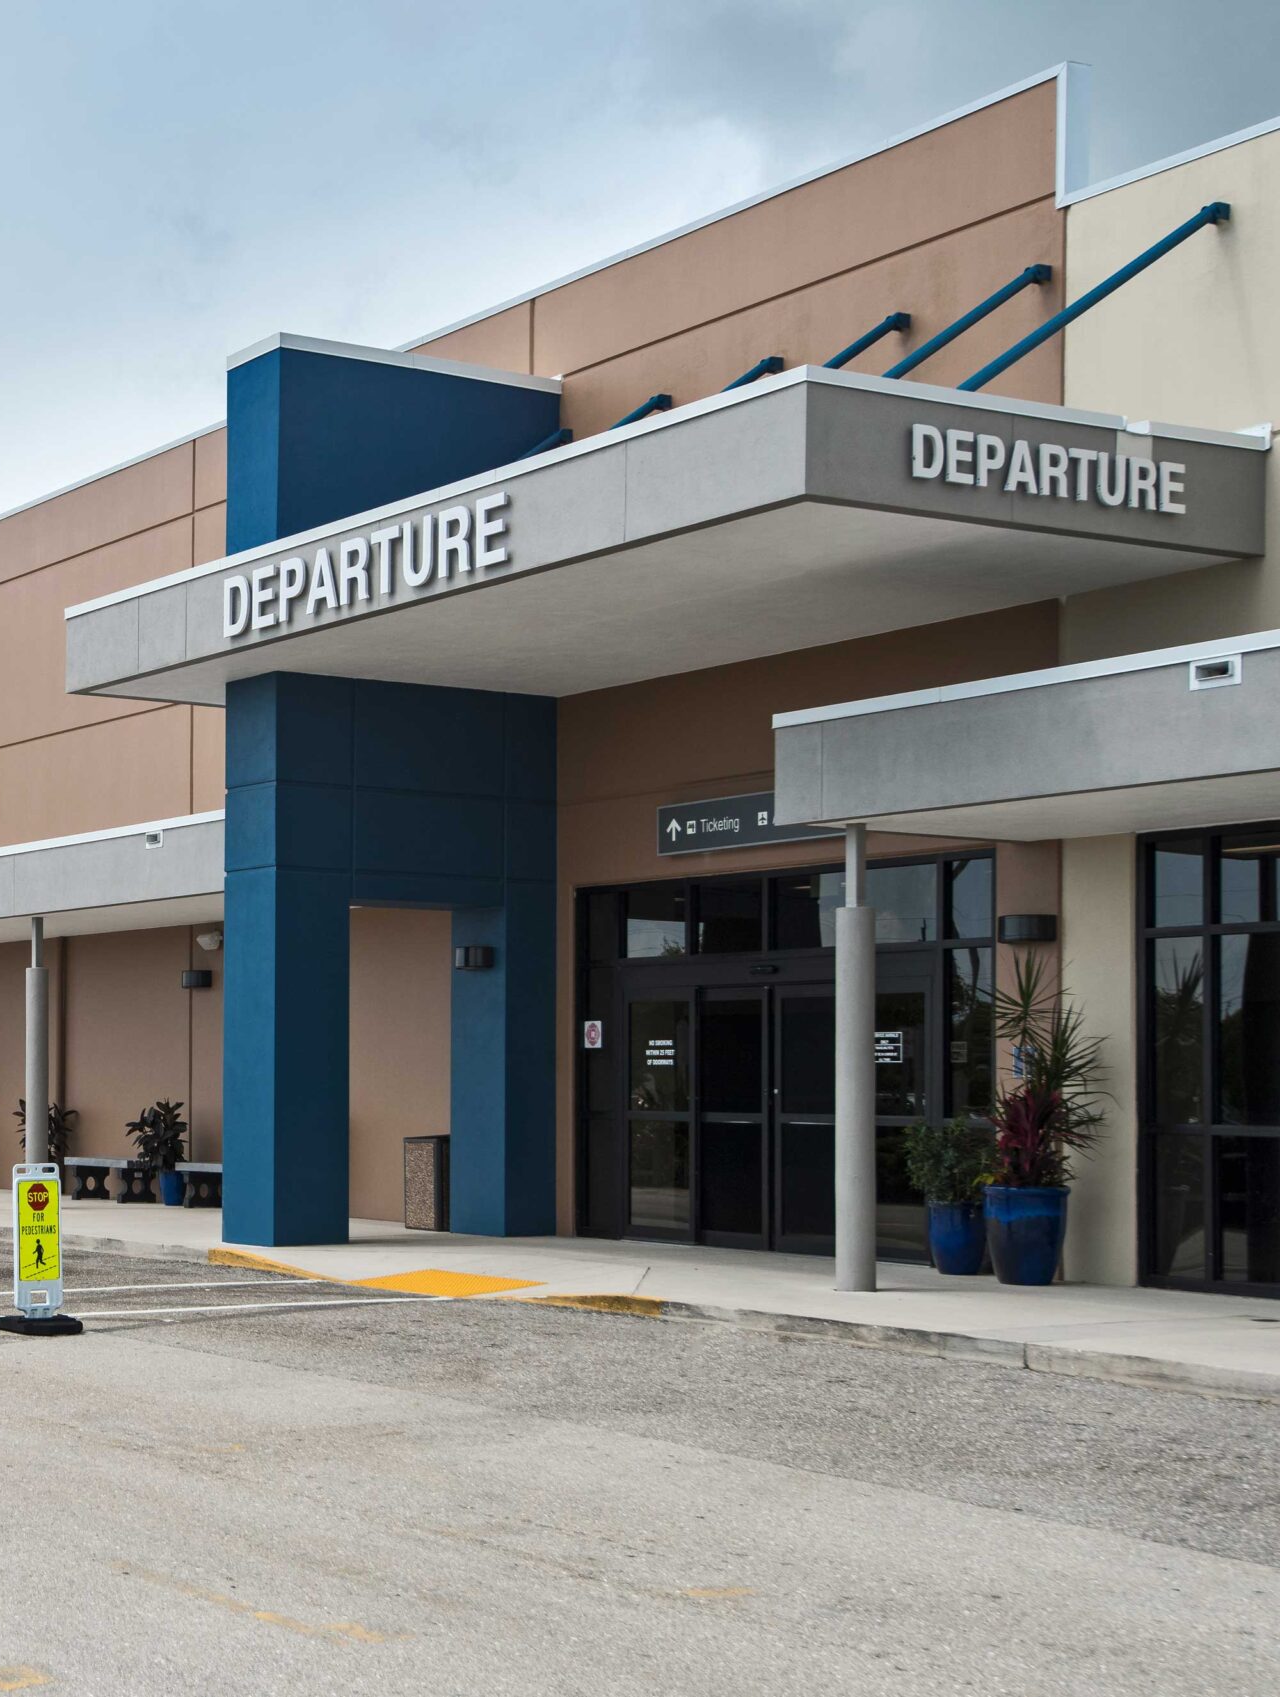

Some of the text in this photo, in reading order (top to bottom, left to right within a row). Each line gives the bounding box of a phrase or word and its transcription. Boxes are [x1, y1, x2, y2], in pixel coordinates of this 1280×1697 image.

[912, 423, 1186, 514] DEPARTURE
[223, 491, 508, 638] DEPARTURE
[700, 815, 740, 833] Ticketing
[28, 1192, 49, 1203] STOP
[32, 1212, 45, 1222] FOR
[21, 1224, 57, 1235] PEDESTRIANS
